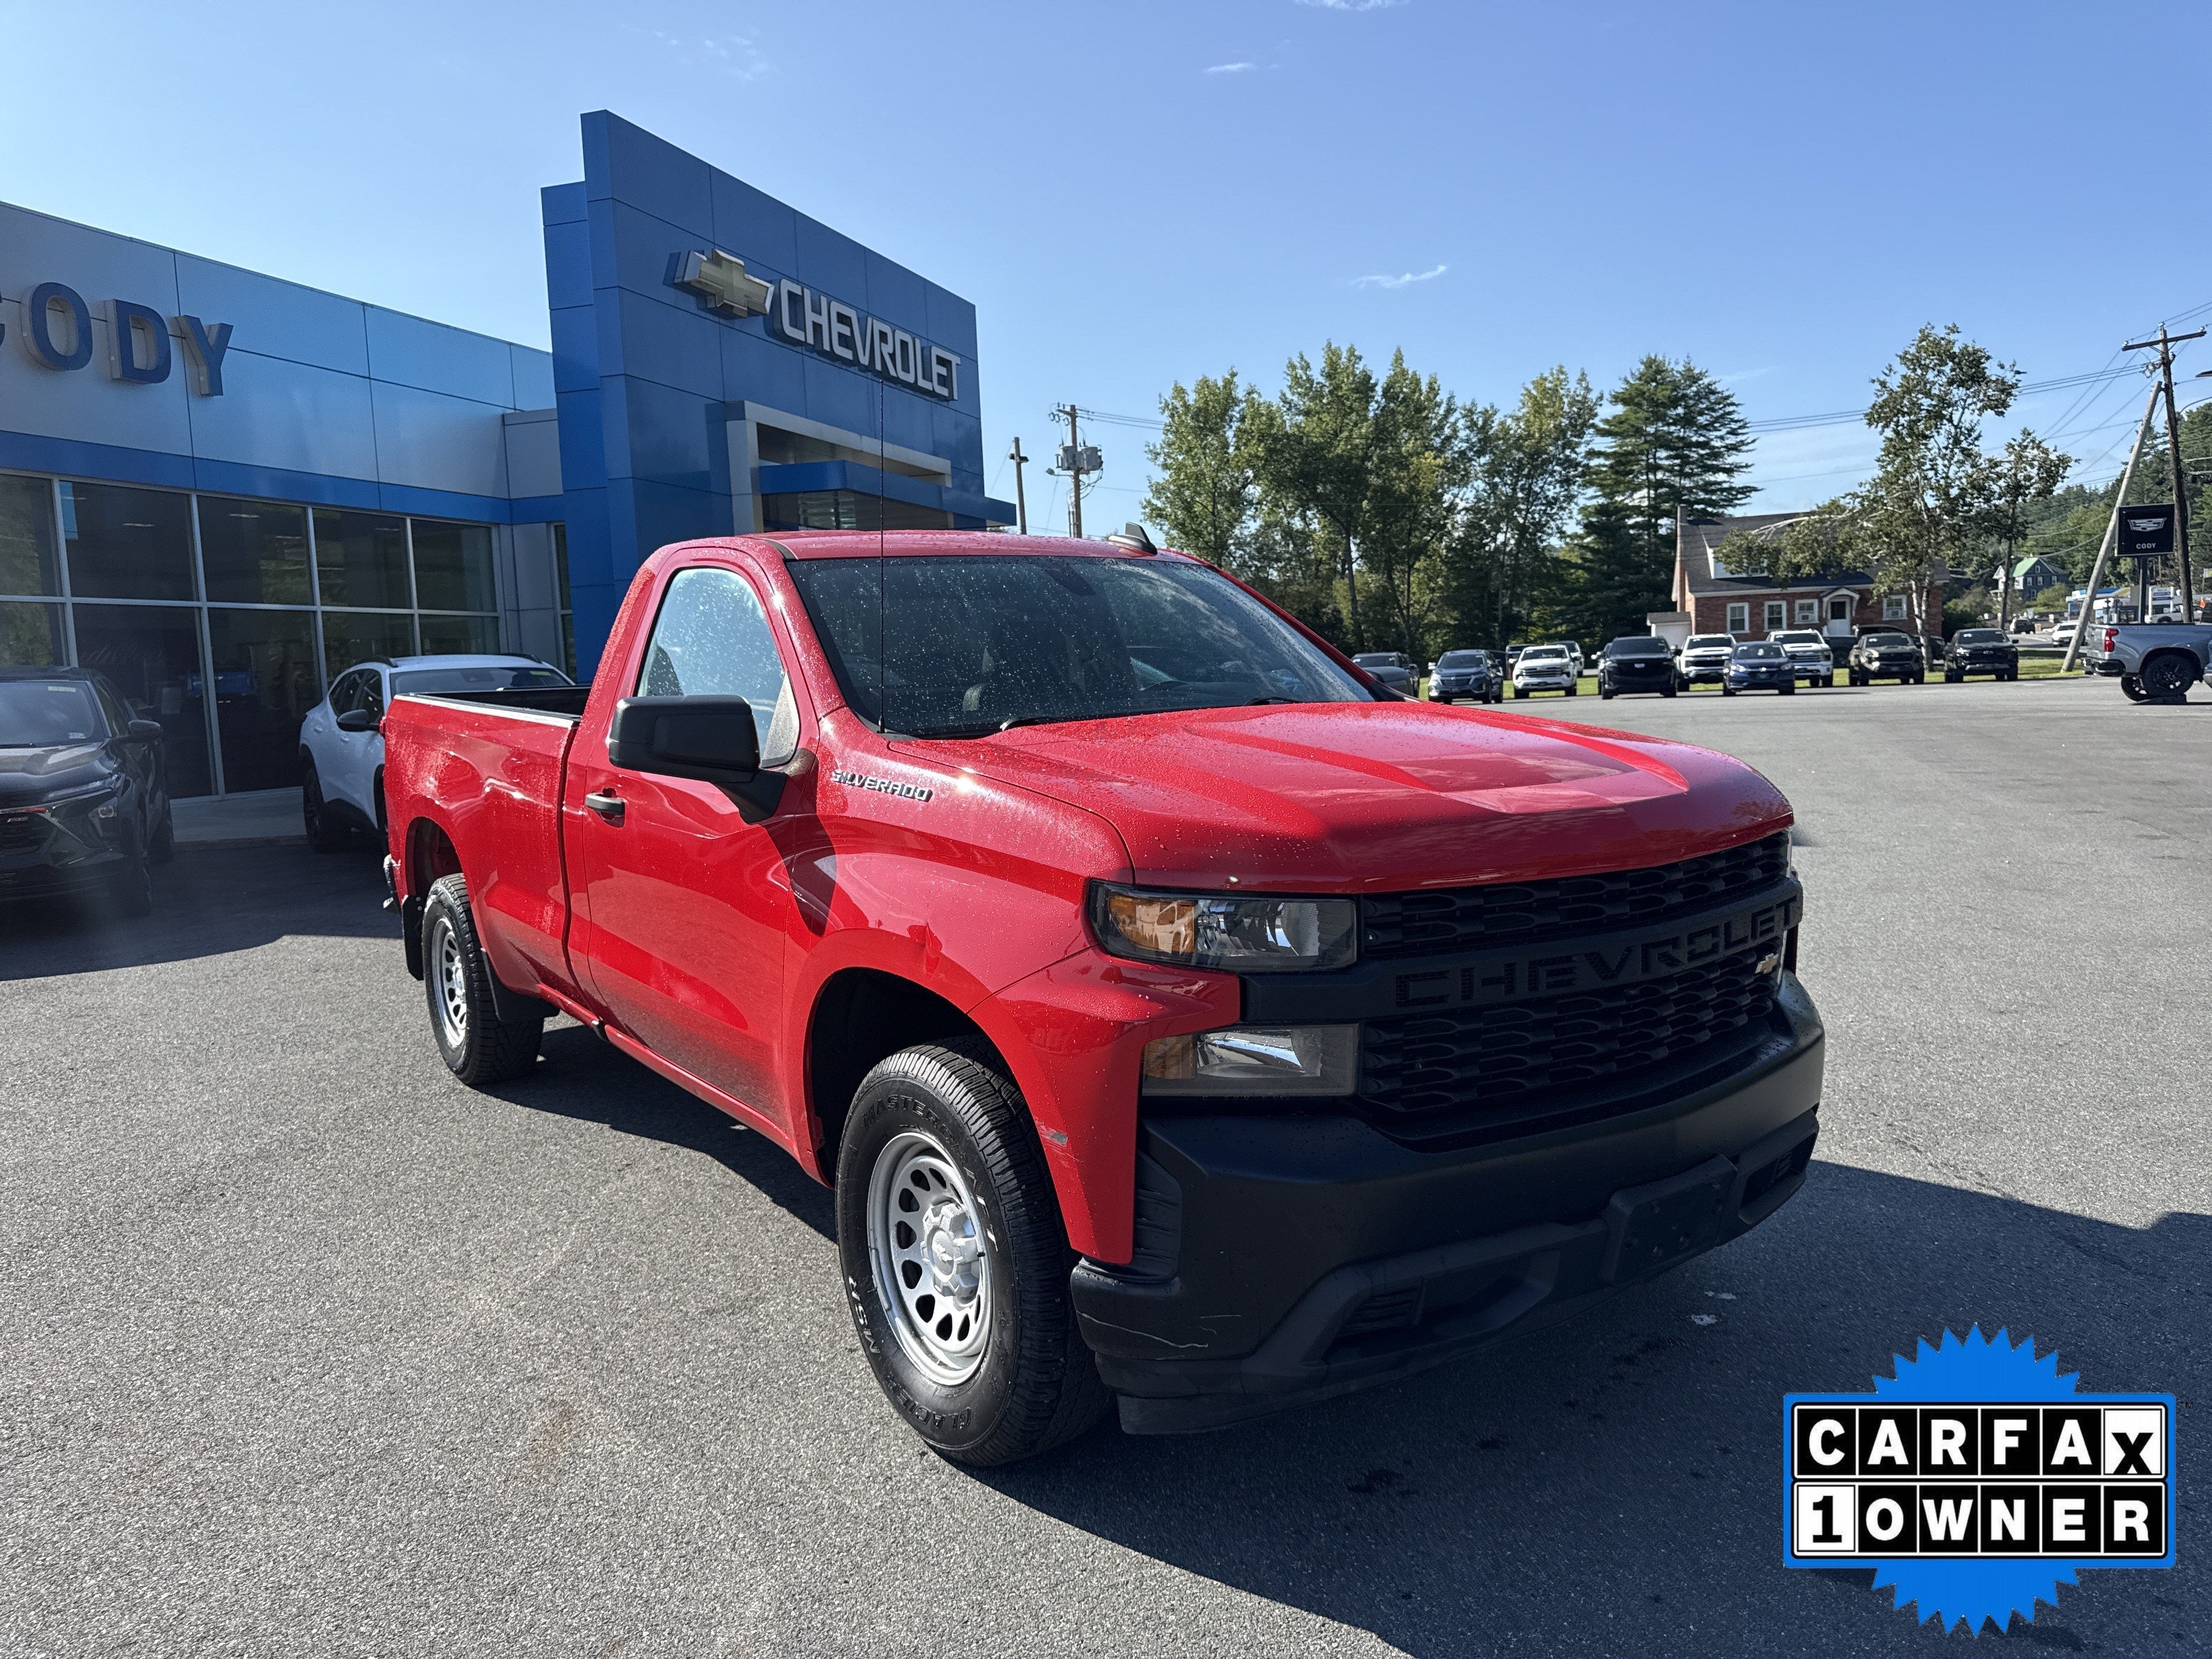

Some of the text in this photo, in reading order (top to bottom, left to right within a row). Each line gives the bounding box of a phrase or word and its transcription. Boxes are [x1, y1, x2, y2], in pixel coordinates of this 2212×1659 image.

[0, 281, 234, 397] ODY
[780, 278, 961, 401] CHEVROLET
[831, 770, 934, 803] SILVERADO
[1395, 895, 1797, 1007] CHEVROLET
